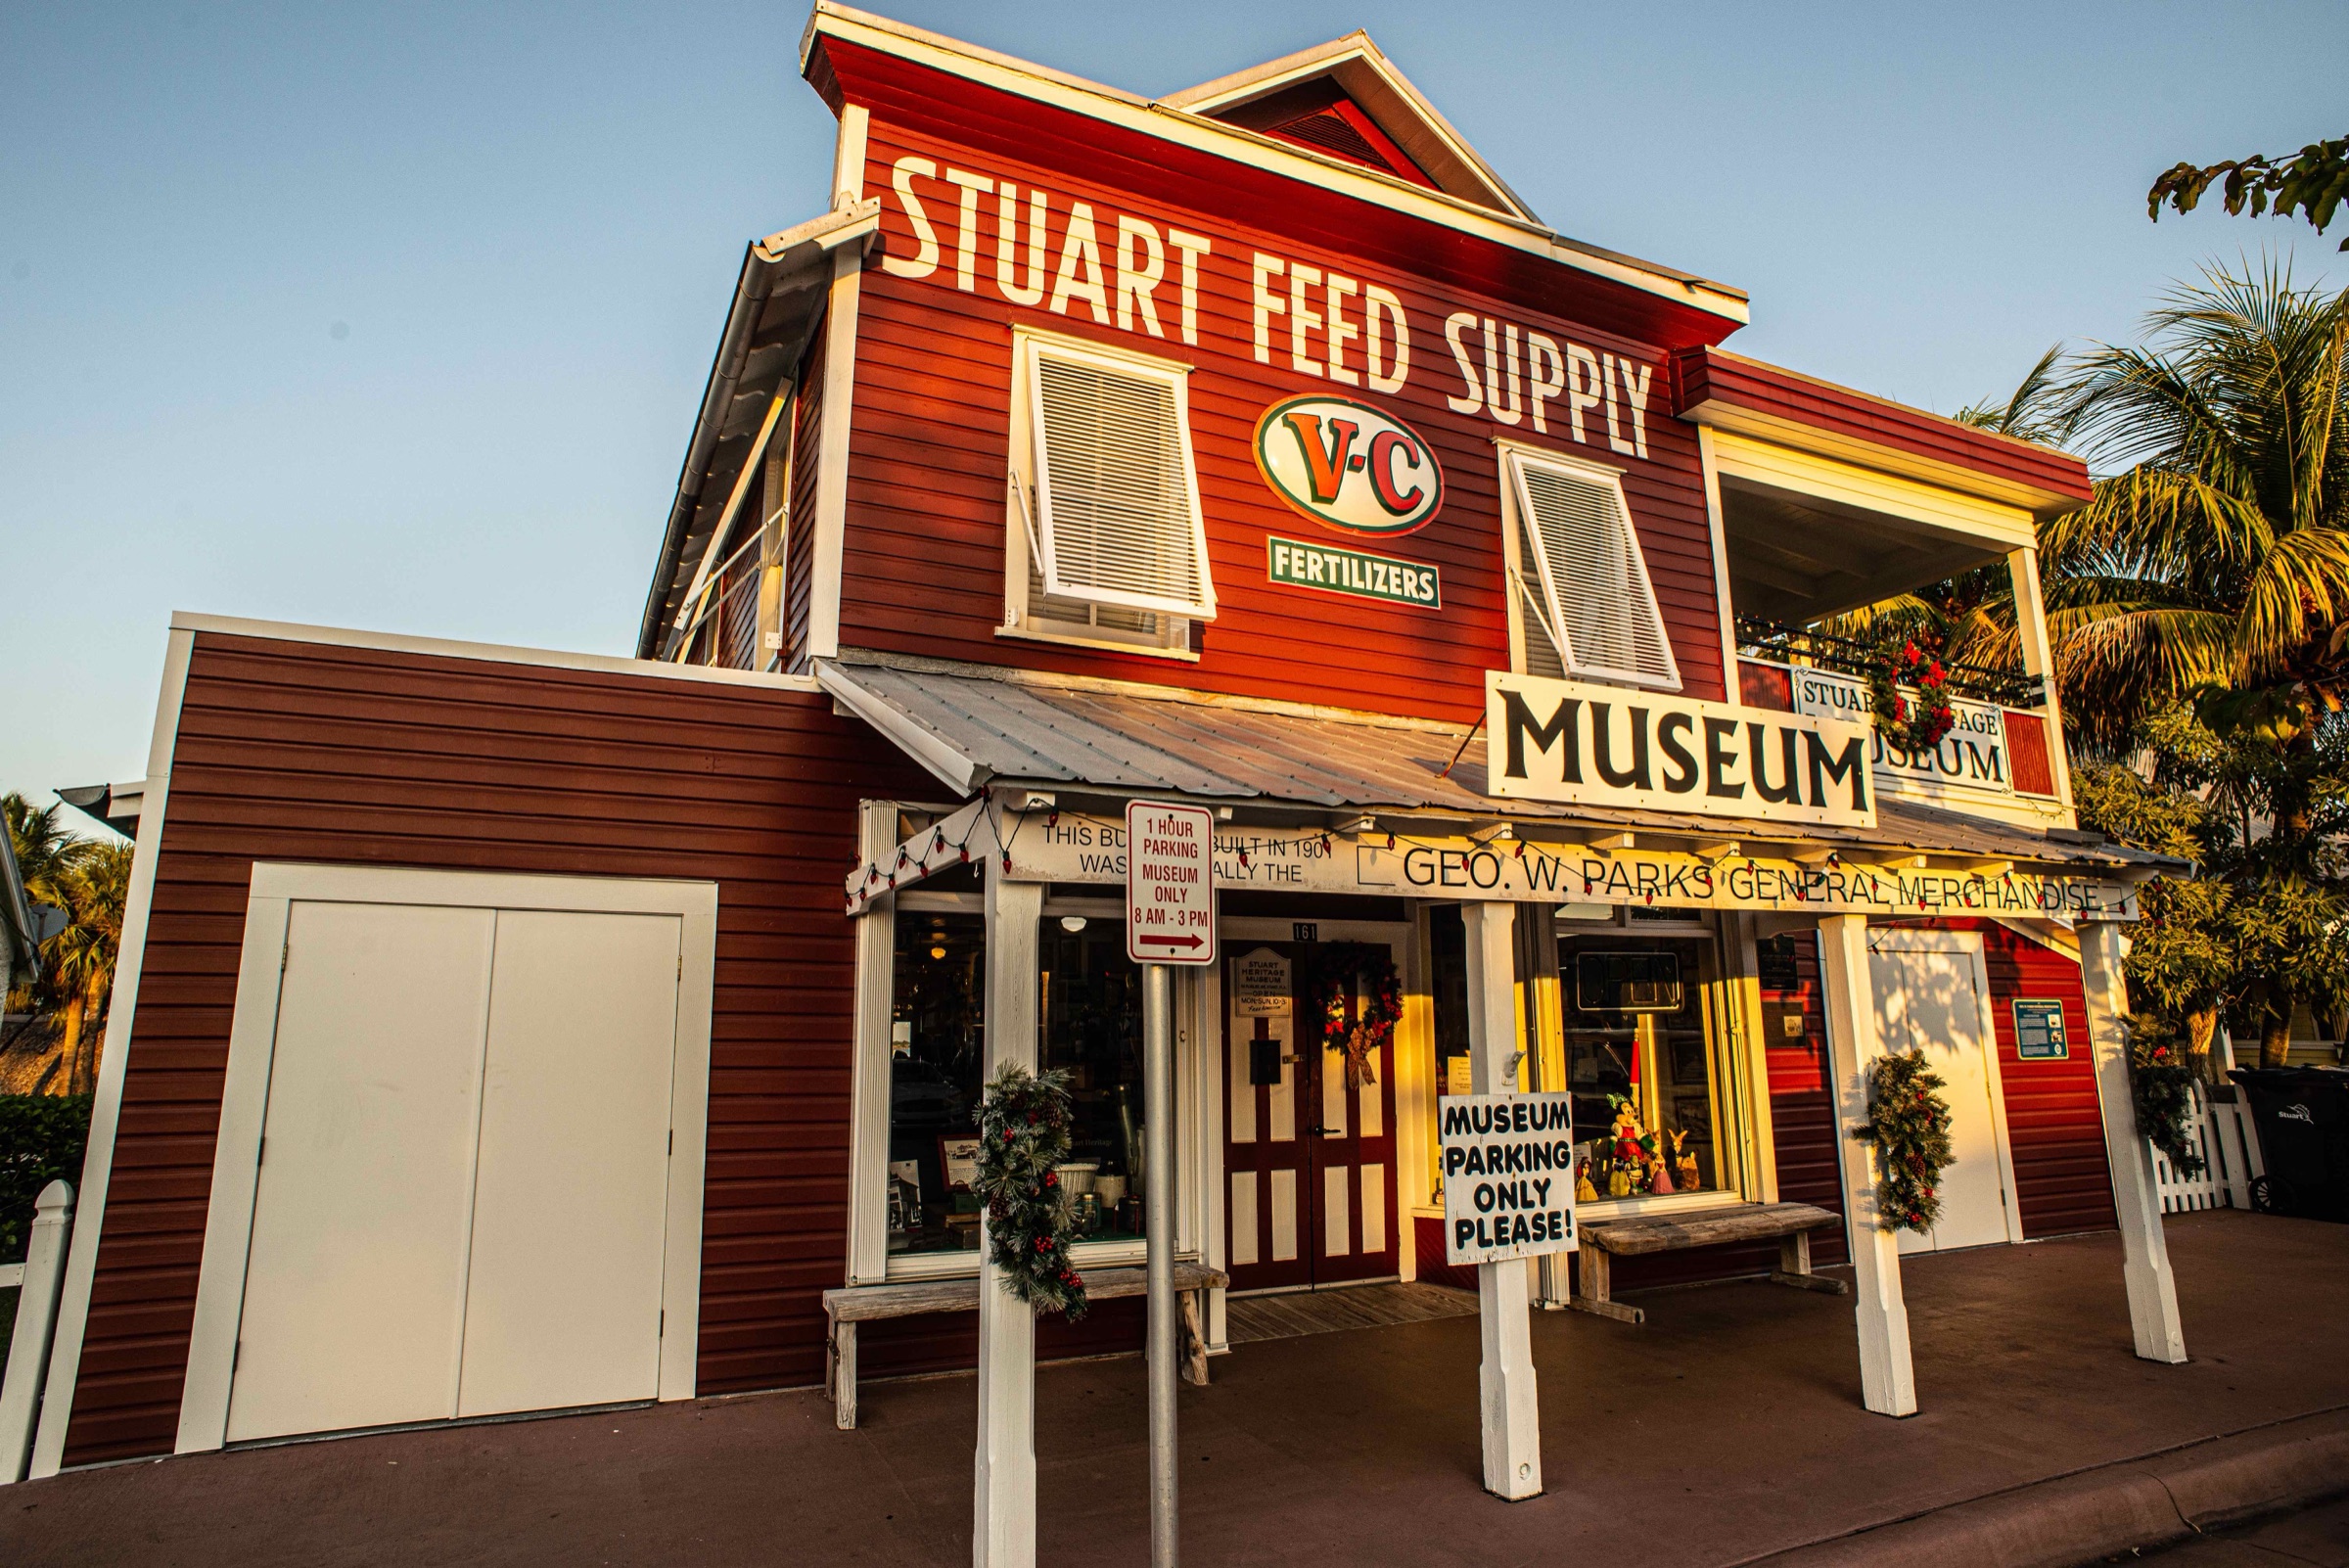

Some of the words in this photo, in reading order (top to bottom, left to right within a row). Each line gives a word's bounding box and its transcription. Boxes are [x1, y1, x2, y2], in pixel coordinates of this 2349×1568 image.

[882, 156, 1212, 346] STUART
[1252, 251, 1410, 395] FEED
[1444, 311, 1652, 460] SUPPLY
[1282, 411, 1425, 518] V-C
[1272, 544, 1436, 603] FERTILIZERS
[1804, 680, 1875, 714] STUAR
[1496, 688, 1870, 812] MUSEUM
[1870, 724, 2004, 783] USEUM
[1041, 825, 1092, 847] THIS
[1267, 838, 1286, 857] IN
[1293, 840, 1331, 859] 190
[1147, 817, 1153, 834] 1
[1158, 818, 1193, 838] HOUR
[1143, 838, 1198, 858] PARKING
[1080, 853, 1127, 875] WAS
[1264, 862, 1303, 882] THE
[1142, 863, 1198, 884] MUSEUM
[1404, 847, 1510, 890] GEO.
[1521, 854, 1569, 893] W.
[1582, 857, 1716, 899] PARKS
[1729, 866, 1890, 905] GENERAL
[1898, 875, 2102, 911] MERCHANDISE
[1155, 886, 1187, 903] ONLY
[1134, 907, 1142, 924] 8
[1146, 907, 1166, 925] AM
[1177, 909, 1185, 926] 3
[1189, 910, 1208, 927] PM
[1295, 925, 1315, 940] 161
[1241, 968, 1285, 977] HERITAGE
[1444, 1100, 1571, 1135] MUSEUM
[2279, 1111, 2304, 1120] Stuart
[1446, 1139, 1571, 1176] PARKING
[1473, 1176, 1551, 1213] ONLY
[1455, 1208, 1573, 1250] PLEASE!
